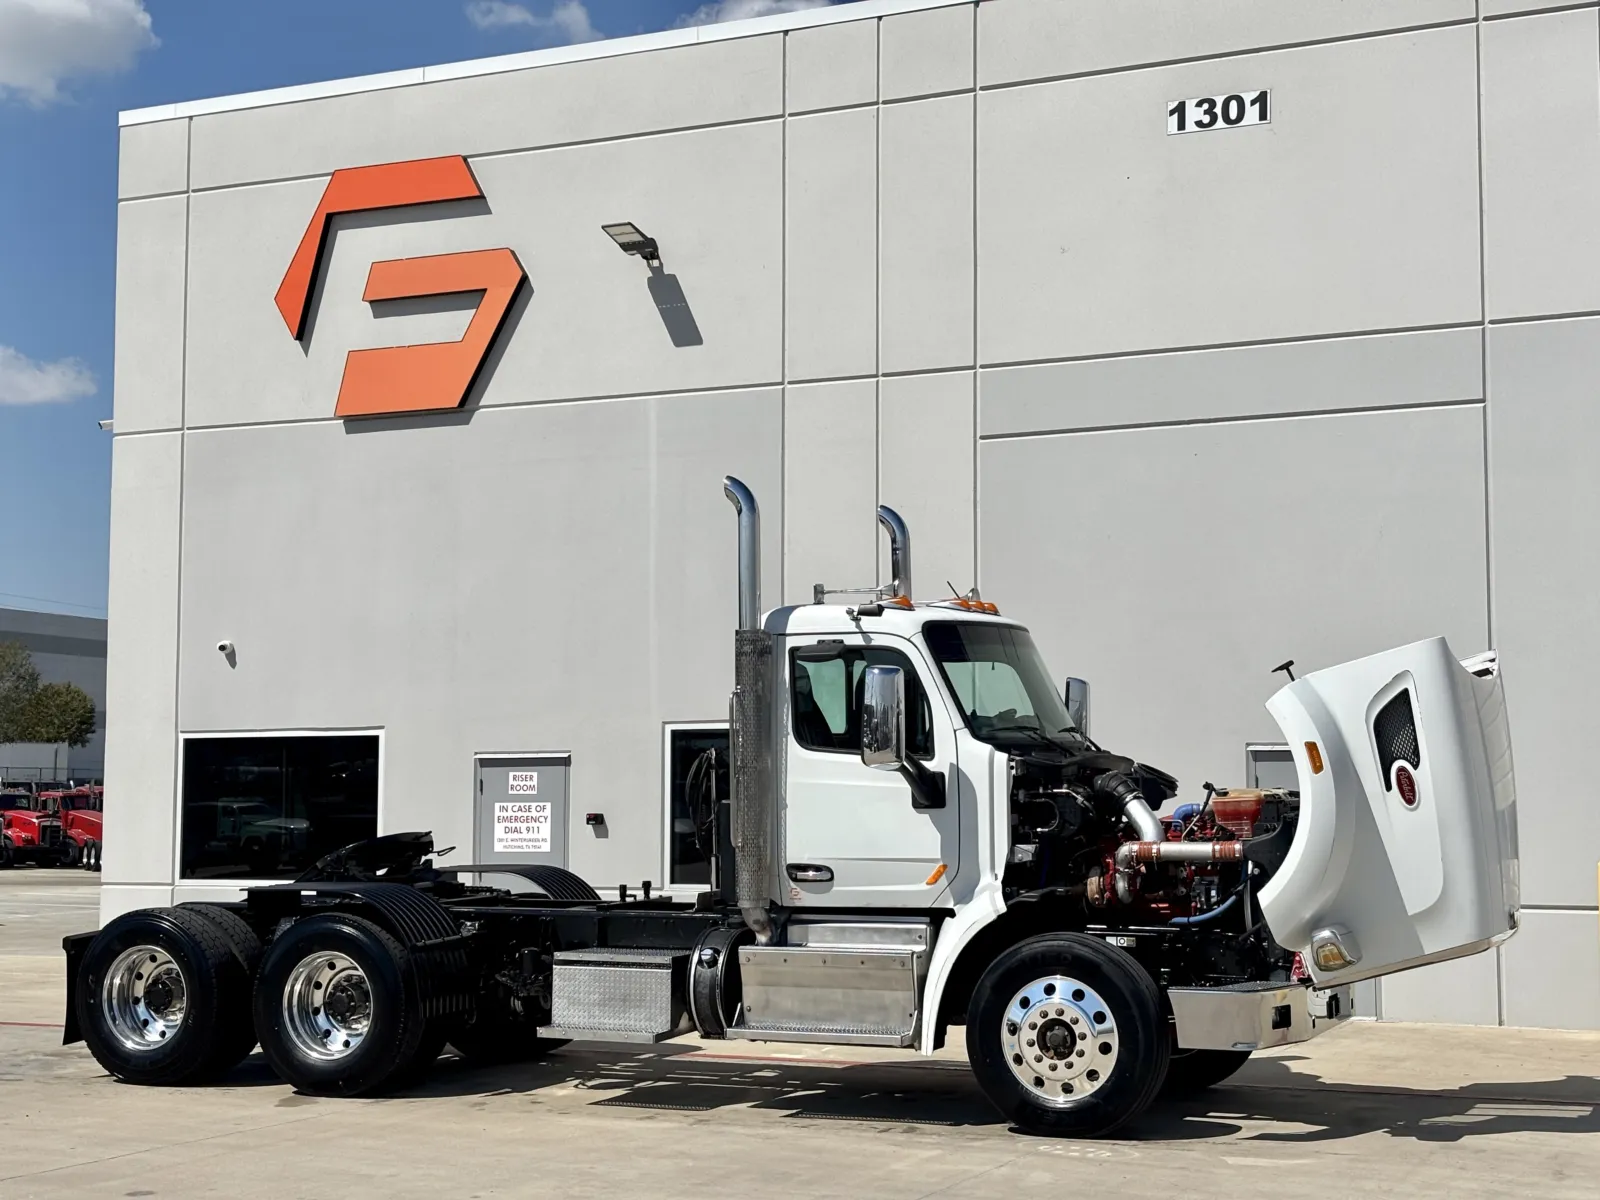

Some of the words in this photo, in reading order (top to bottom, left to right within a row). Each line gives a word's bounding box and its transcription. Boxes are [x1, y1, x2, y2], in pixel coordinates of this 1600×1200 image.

[1168, 90, 1268, 132] 1301
[512, 774, 534, 782] RISER
[510, 784, 536, 792] ROOM
[1397, 771, 1414, 801] Peterbilt
[499, 804, 509, 813] IN
[511, 804, 533, 813] CASE
[535, 804, 547, 813] OF
[497, 815, 548, 824] EMERGENCY
[504, 826, 523, 834] DIAL
[526, 826, 540, 834] 911
